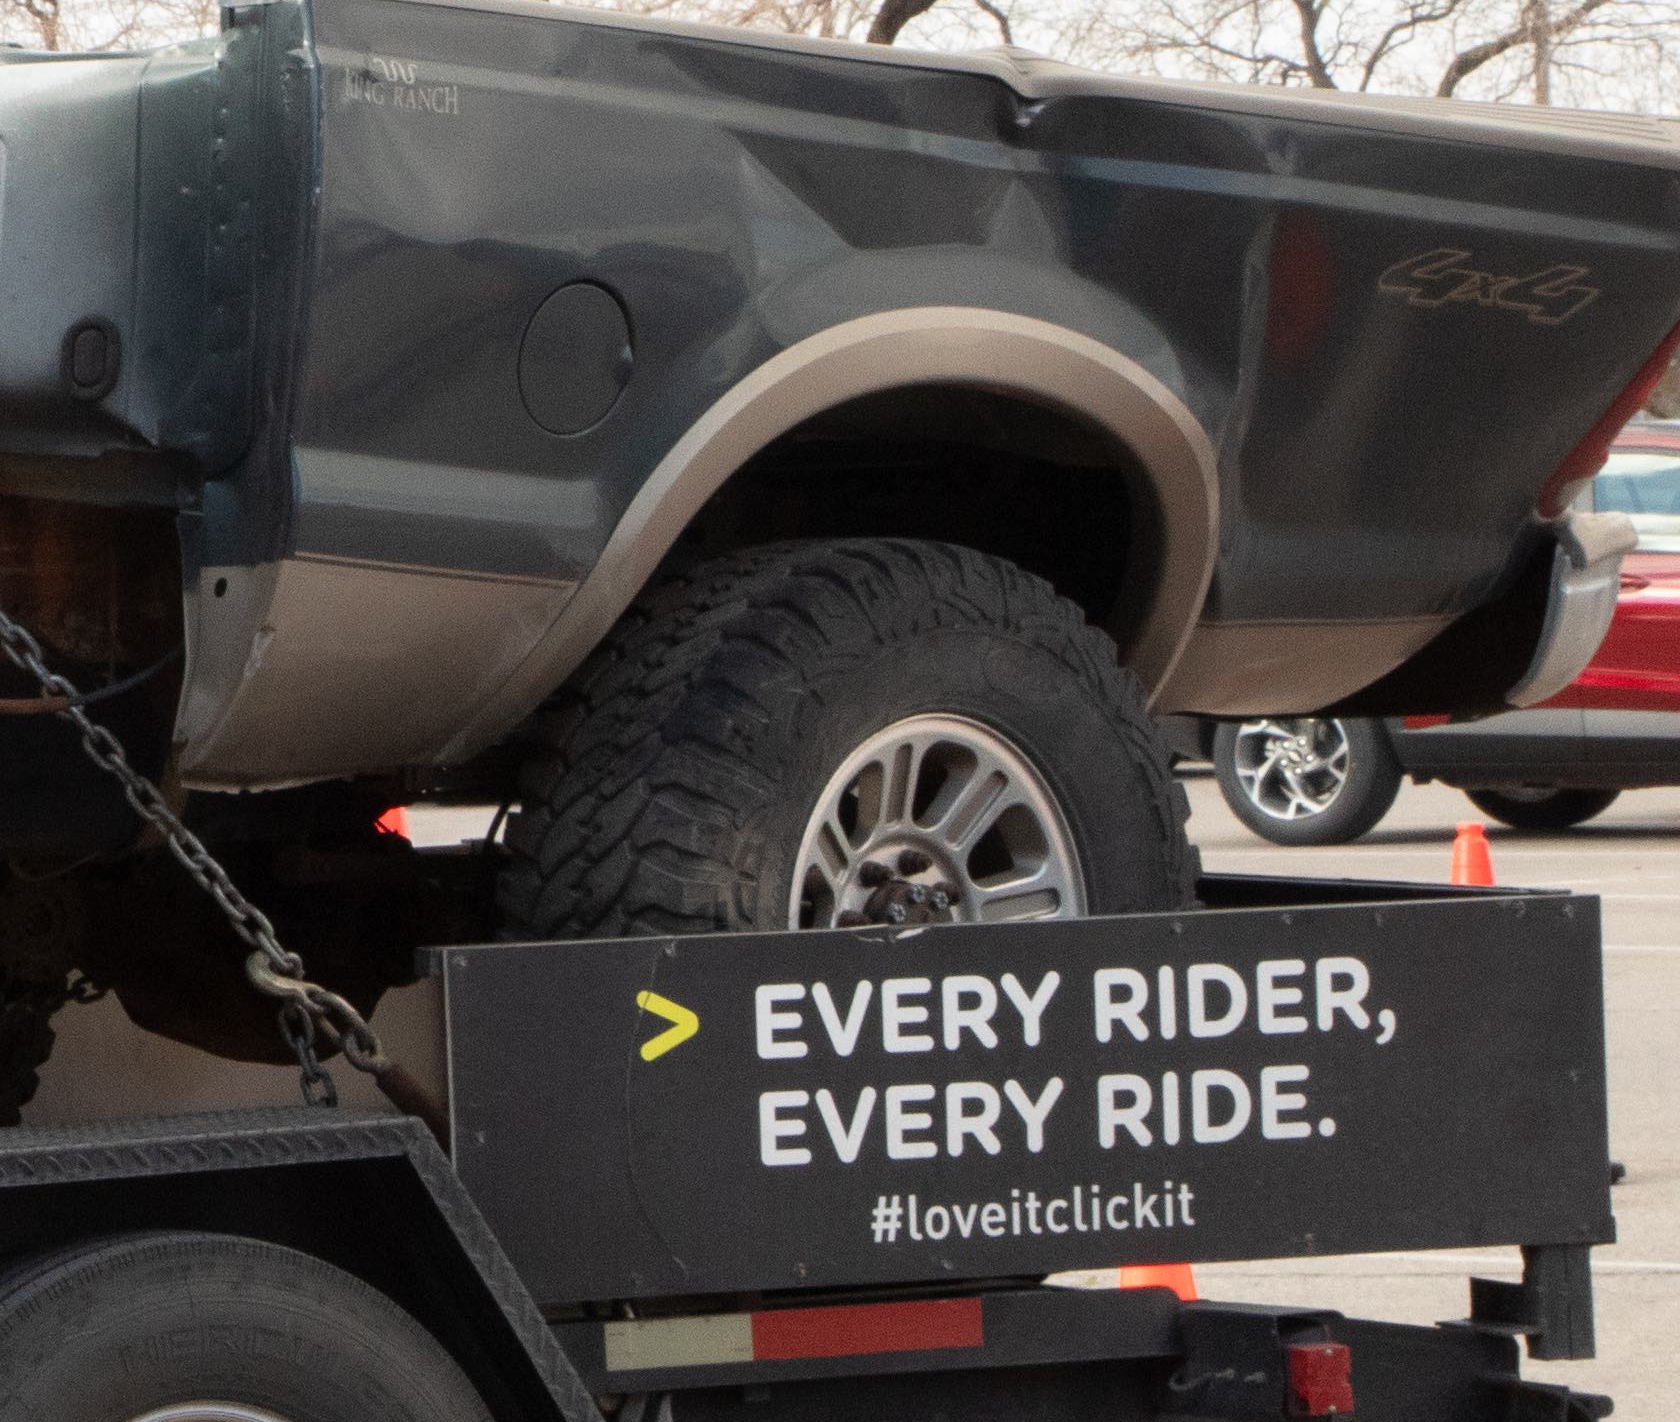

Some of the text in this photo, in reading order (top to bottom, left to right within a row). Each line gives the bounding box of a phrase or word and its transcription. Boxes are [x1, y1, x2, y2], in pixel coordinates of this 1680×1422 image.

[393, 85, 458, 115] RANCH
[755, 957, 1395, 1059] EVERY RIDER,
[759, 1065, 1335, 1166] EVERY RIDE.
[872, 1183, 1193, 1242] #loveitclickit
